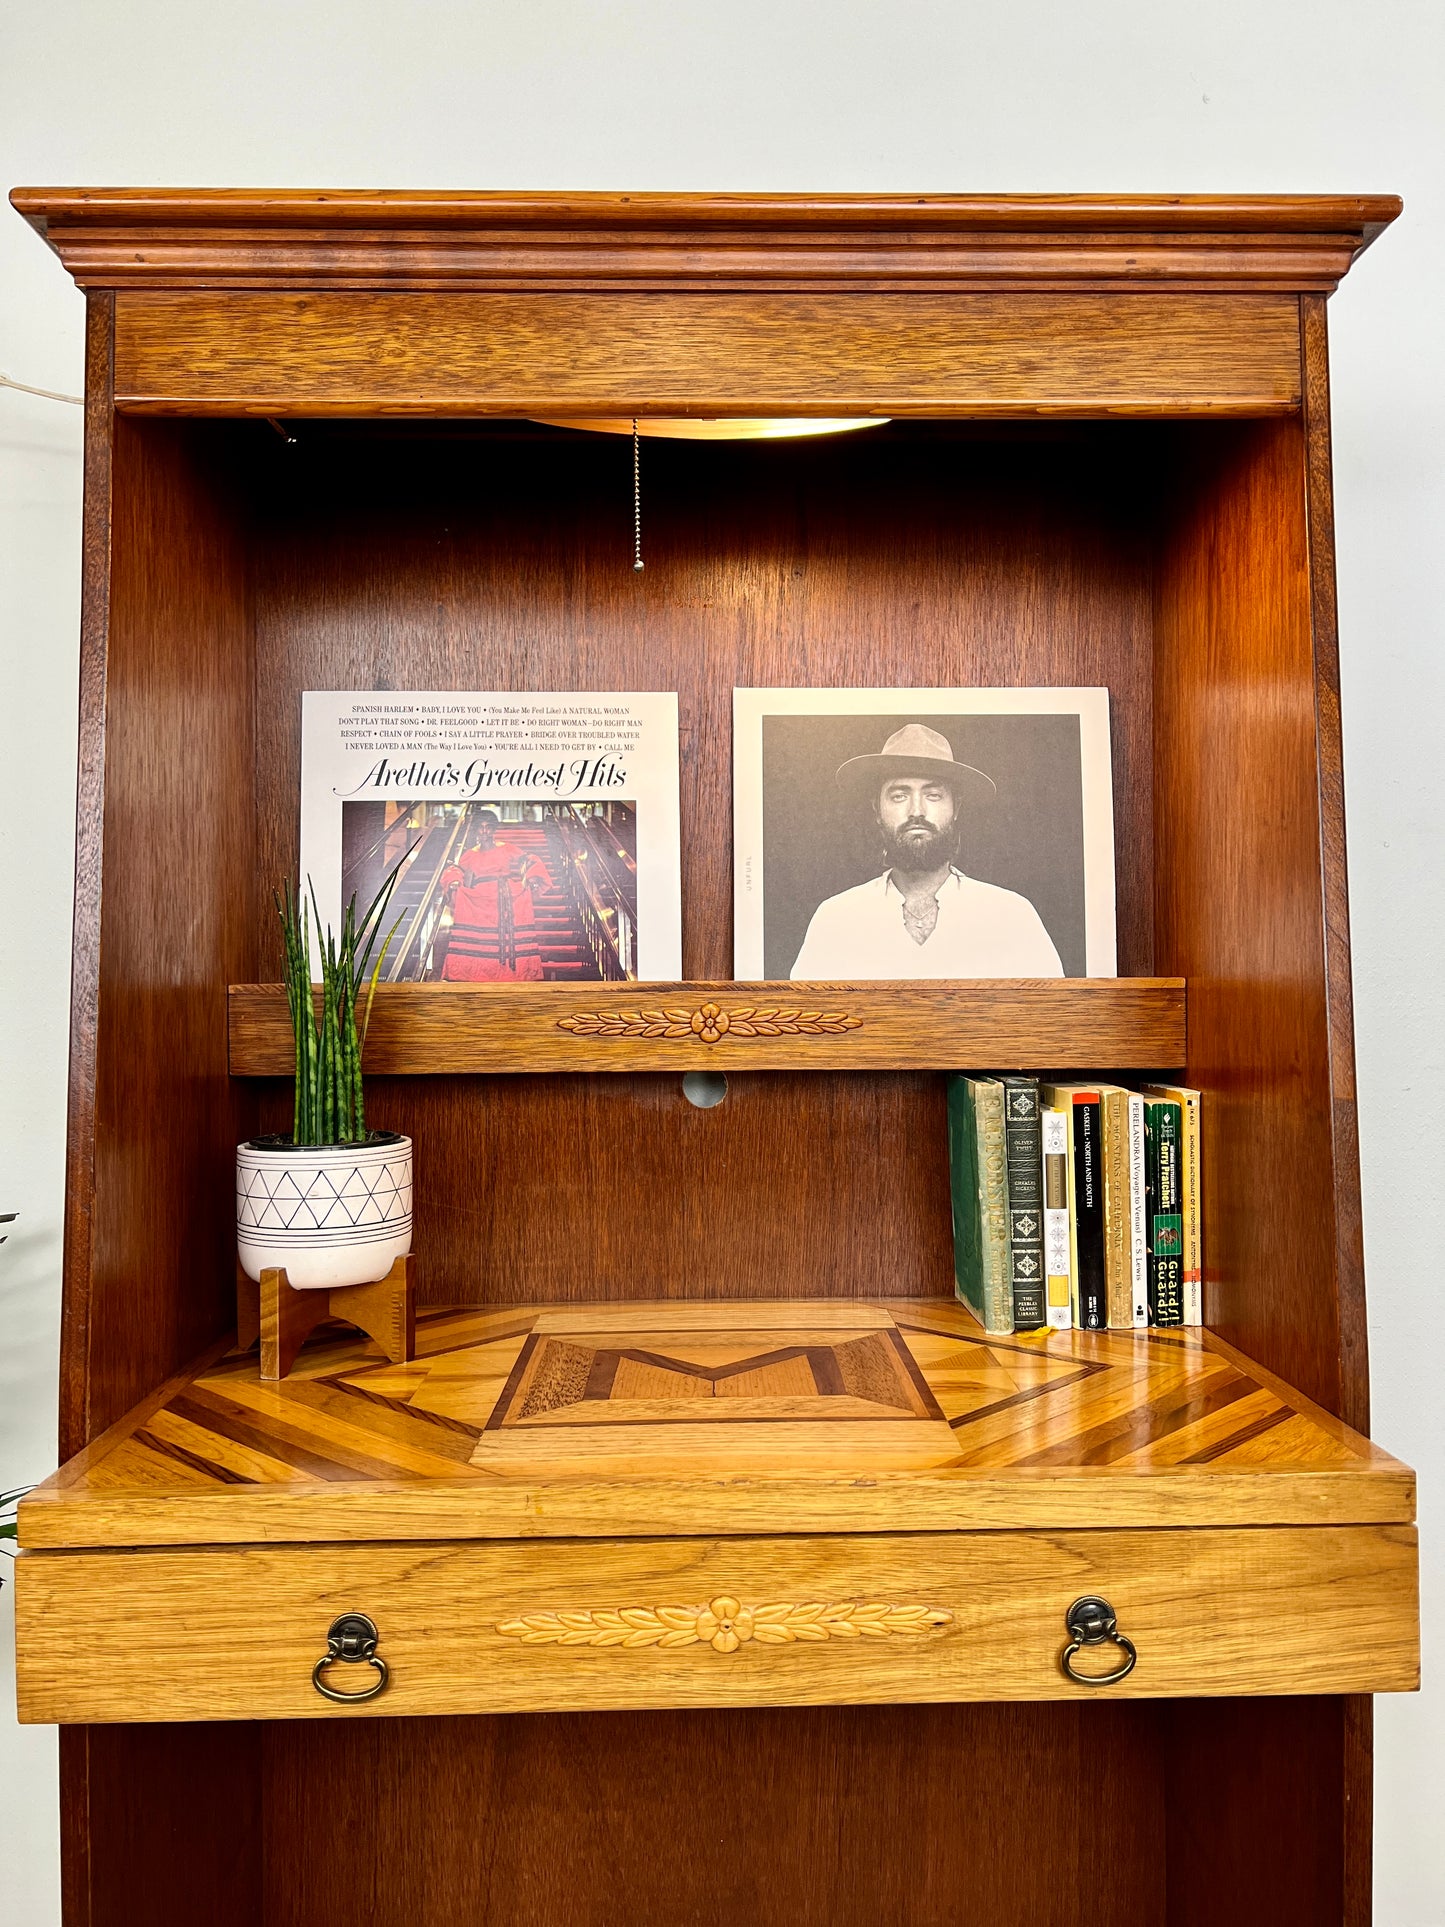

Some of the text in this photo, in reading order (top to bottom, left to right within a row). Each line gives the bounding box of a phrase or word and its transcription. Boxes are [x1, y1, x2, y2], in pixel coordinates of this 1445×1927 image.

[333, 752, 626, 797] Aretha's Greatest Hits
[1161, 1141, 1170, 1165] Terry
[1114, 1180, 1121, 1192] OF
[1135, 1196, 1141, 1204] to
[1161, 1166, 1170, 1208] Pratchett
[1136, 1239, 1142, 1247] C.
[1158, 1262, 1169, 1321] Guards!
[1168, 1261, 1179, 1320] Guards!
